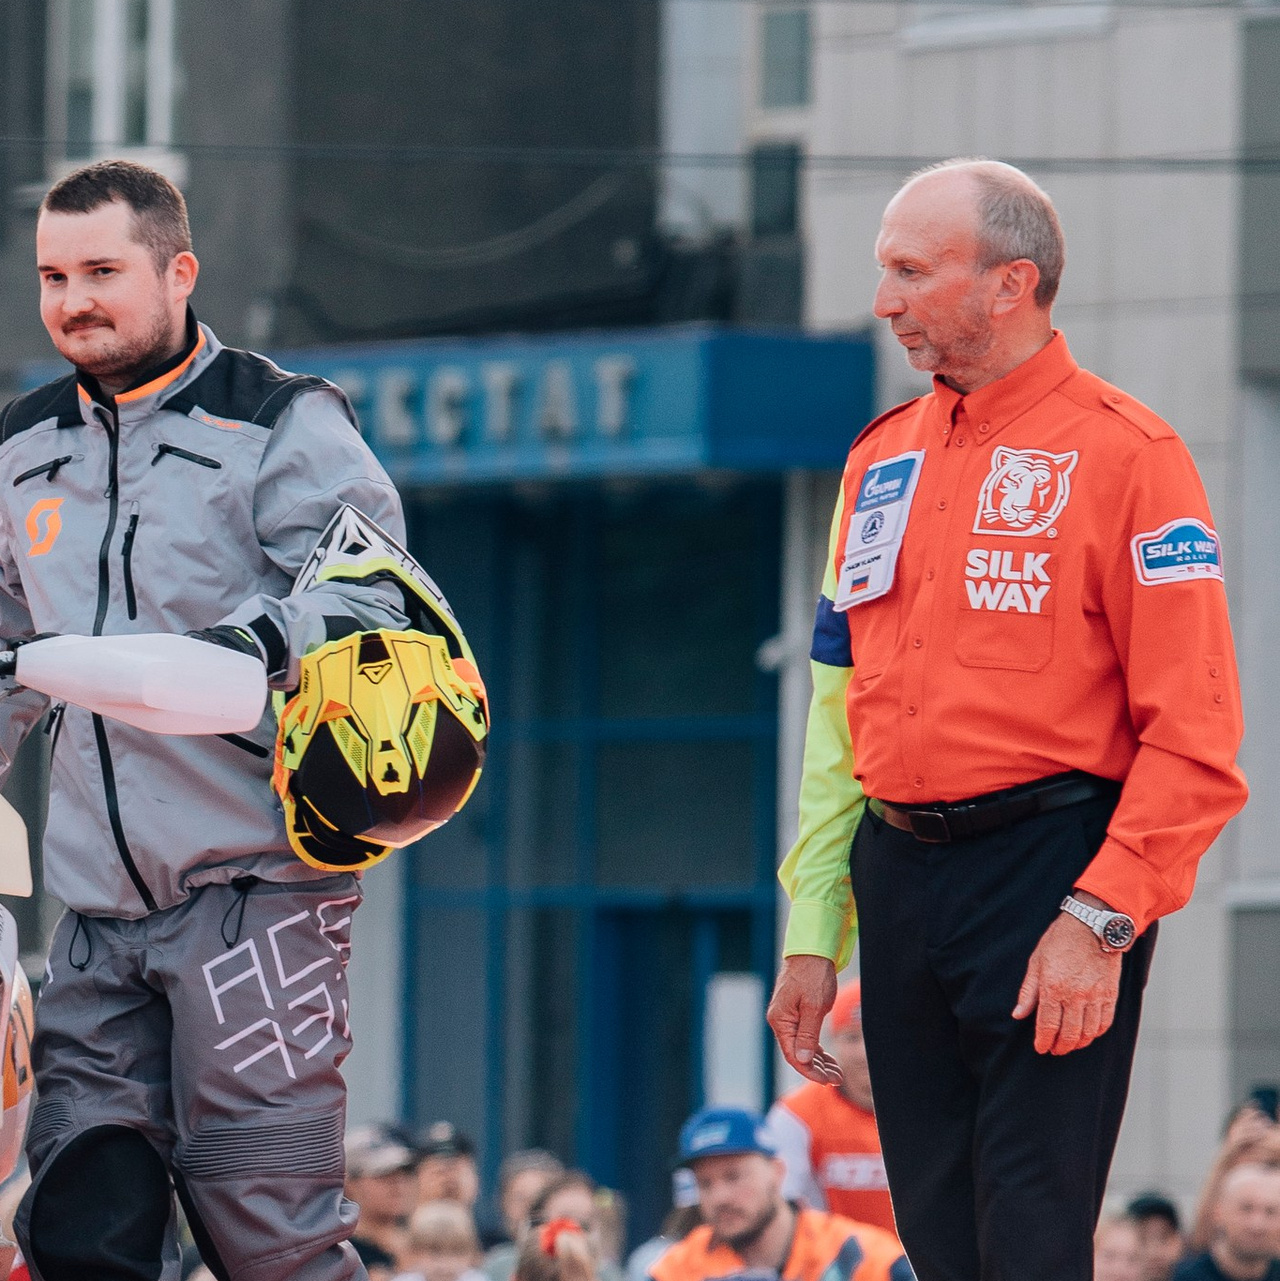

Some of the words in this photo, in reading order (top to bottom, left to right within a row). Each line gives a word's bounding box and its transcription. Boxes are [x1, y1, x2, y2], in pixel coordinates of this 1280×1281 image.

[965, 548, 1051, 582] SILK
[1145, 541, 1192, 560] SILK
[965, 580, 1051, 613] WAY
